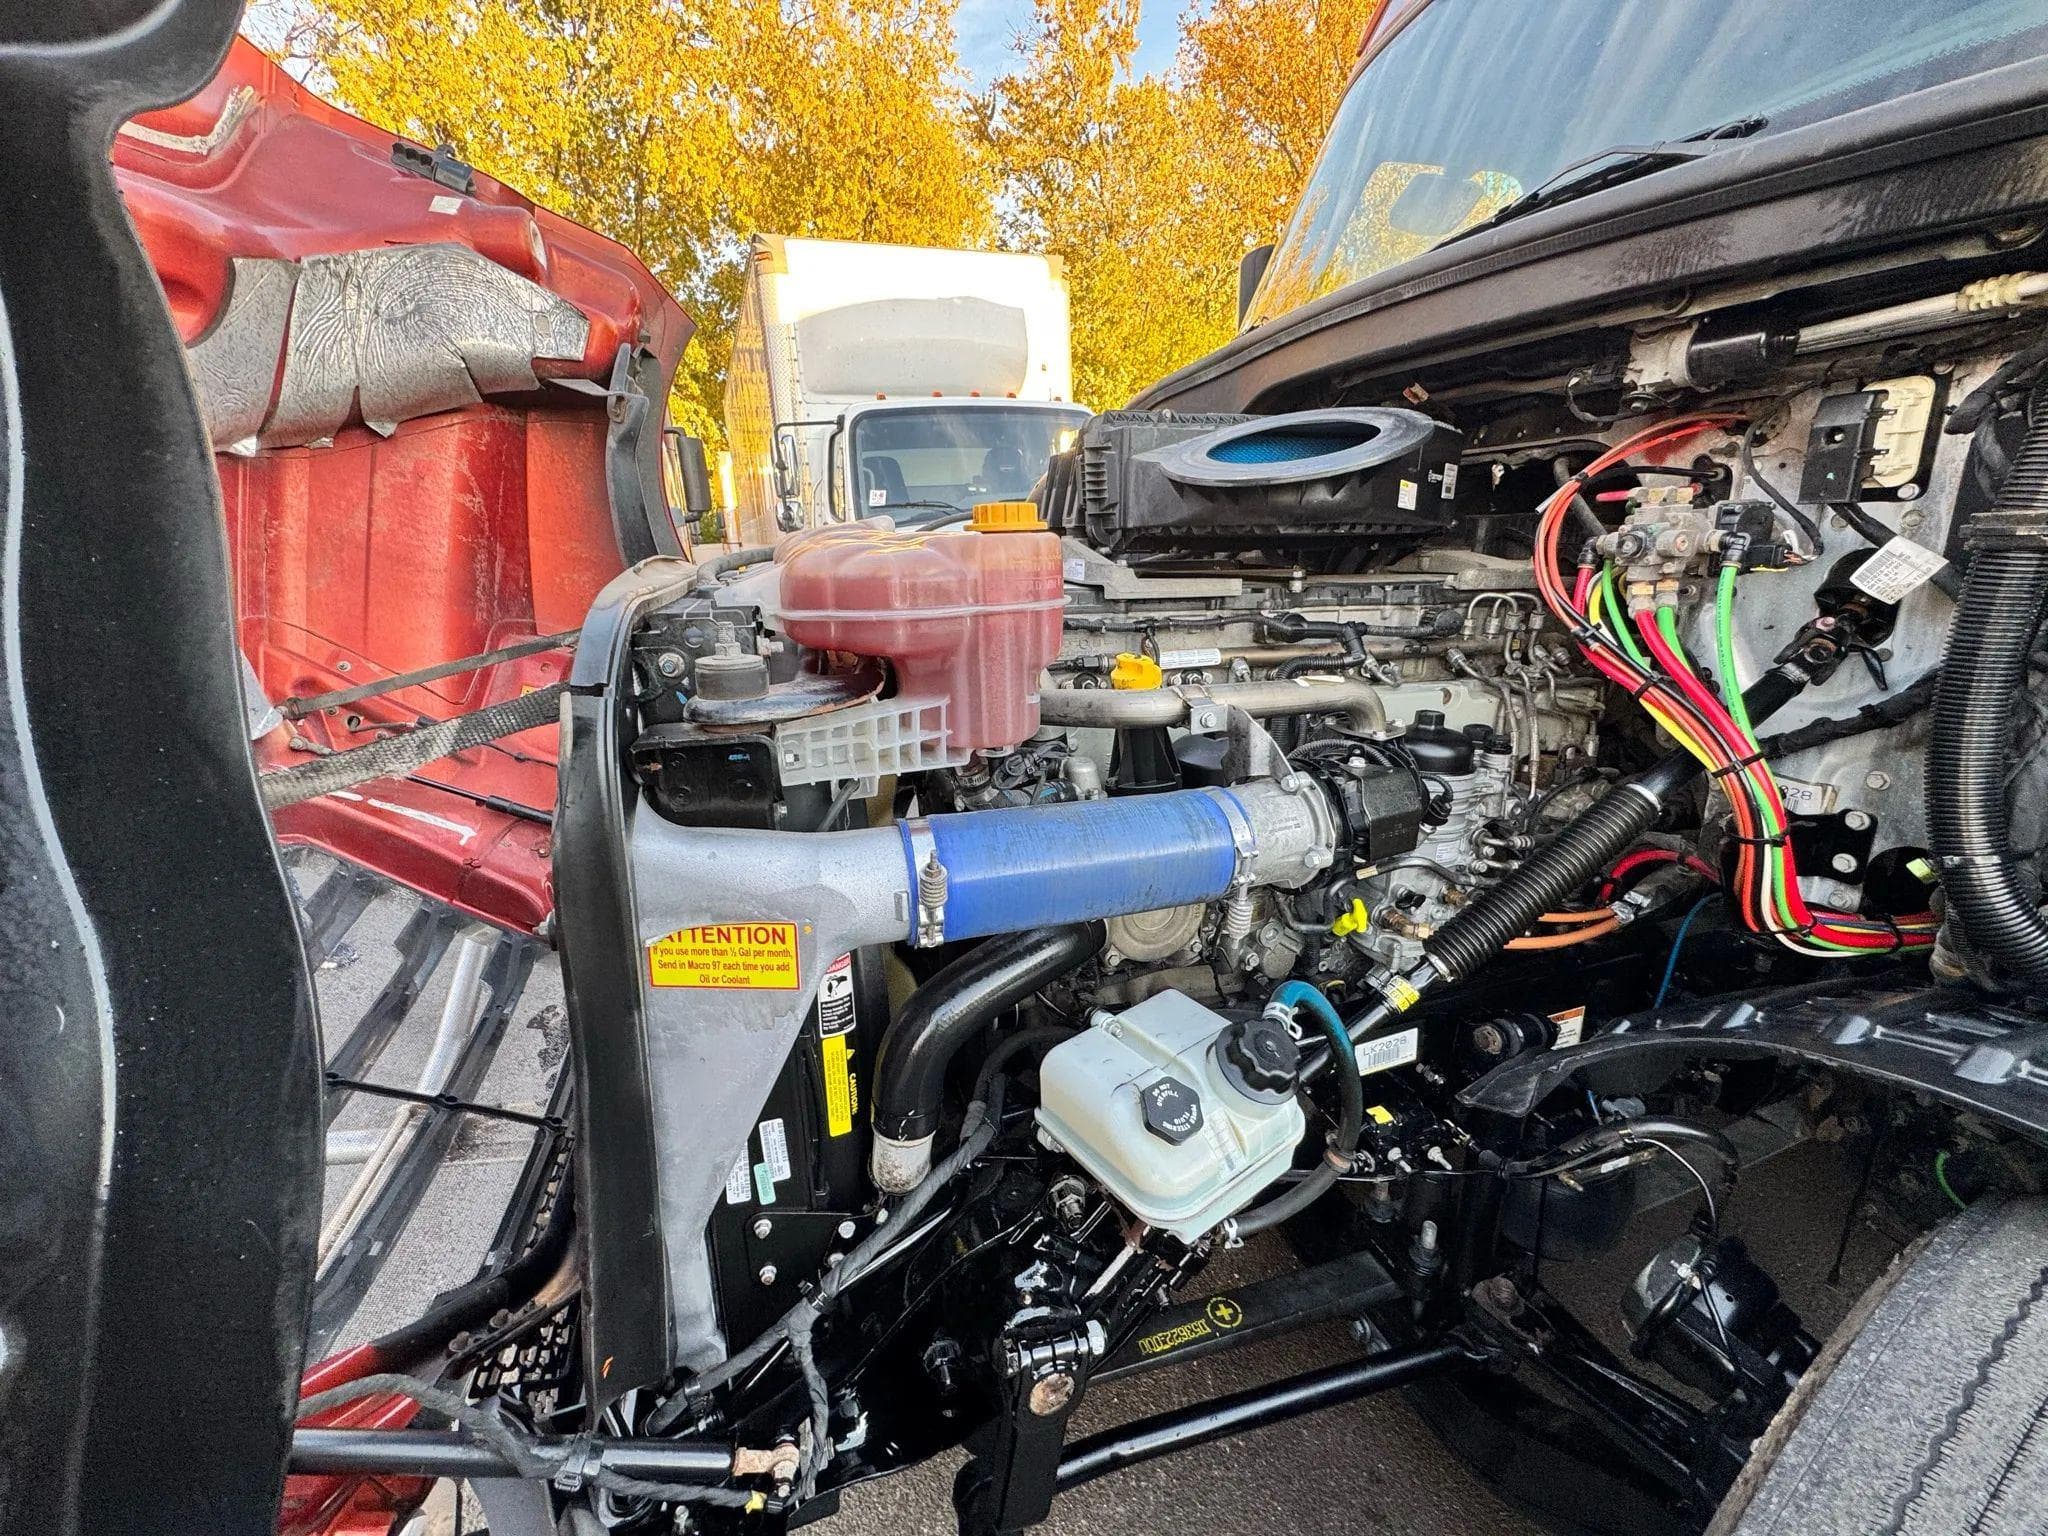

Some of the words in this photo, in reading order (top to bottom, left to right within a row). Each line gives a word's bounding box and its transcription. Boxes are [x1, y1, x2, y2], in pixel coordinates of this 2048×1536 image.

[660, 948, 673, 957] you
[711, 947, 728, 955] than
[739, 947, 751, 957] Gal
[753, 950, 765, 960] per
[658, 960, 677, 969] Send
[678, 960, 686, 969] in
[688, 961, 710, 970] Macro
[711, 961, 721, 970] 97
[723, 961, 740, 971] each
[743, 961, 758, 971] time
[760, 964, 774, 973] you
[776, 962, 790, 971] add
[700, 975, 710, 984] Oil
[711, 976, 720, 984] or
[721, 974, 751, 984] Coolant
